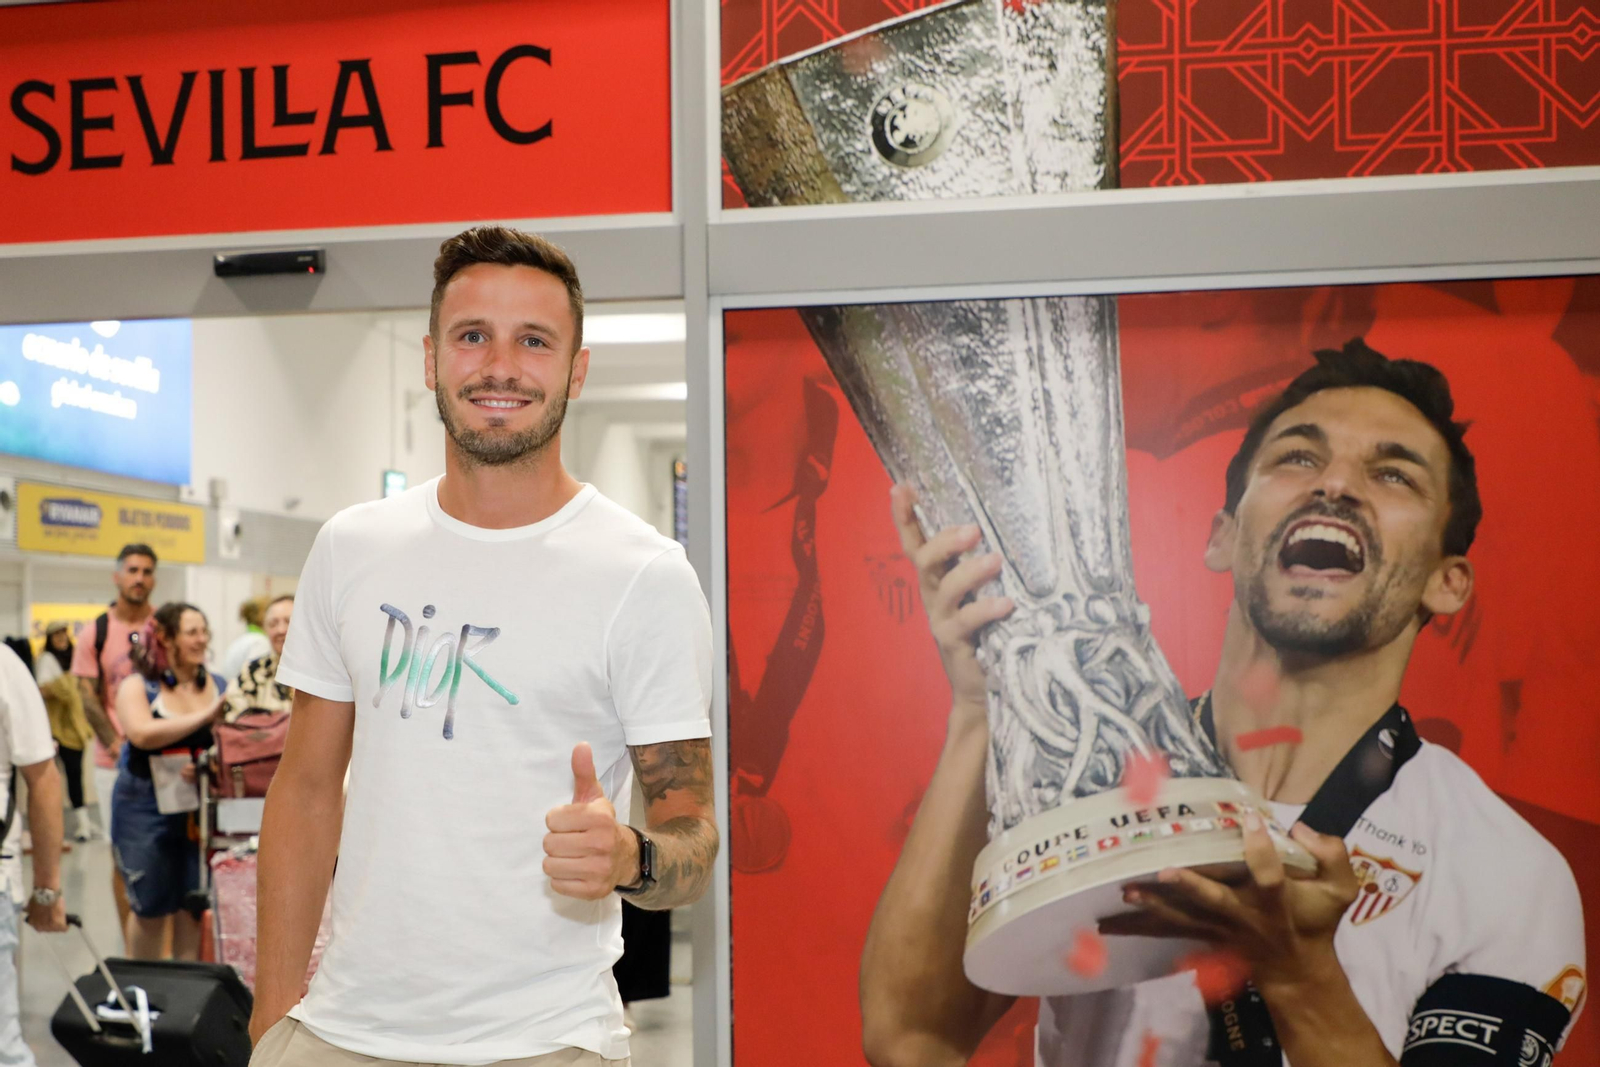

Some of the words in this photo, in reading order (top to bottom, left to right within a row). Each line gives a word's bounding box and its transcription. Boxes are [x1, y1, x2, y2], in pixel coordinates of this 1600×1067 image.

[10, 58, 396, 177] SEVILLA
[425, 44, 553, 149] FC
[1110, 803, 1196, 829] UEFA
[1357, 816, 1406, 848] Thank
